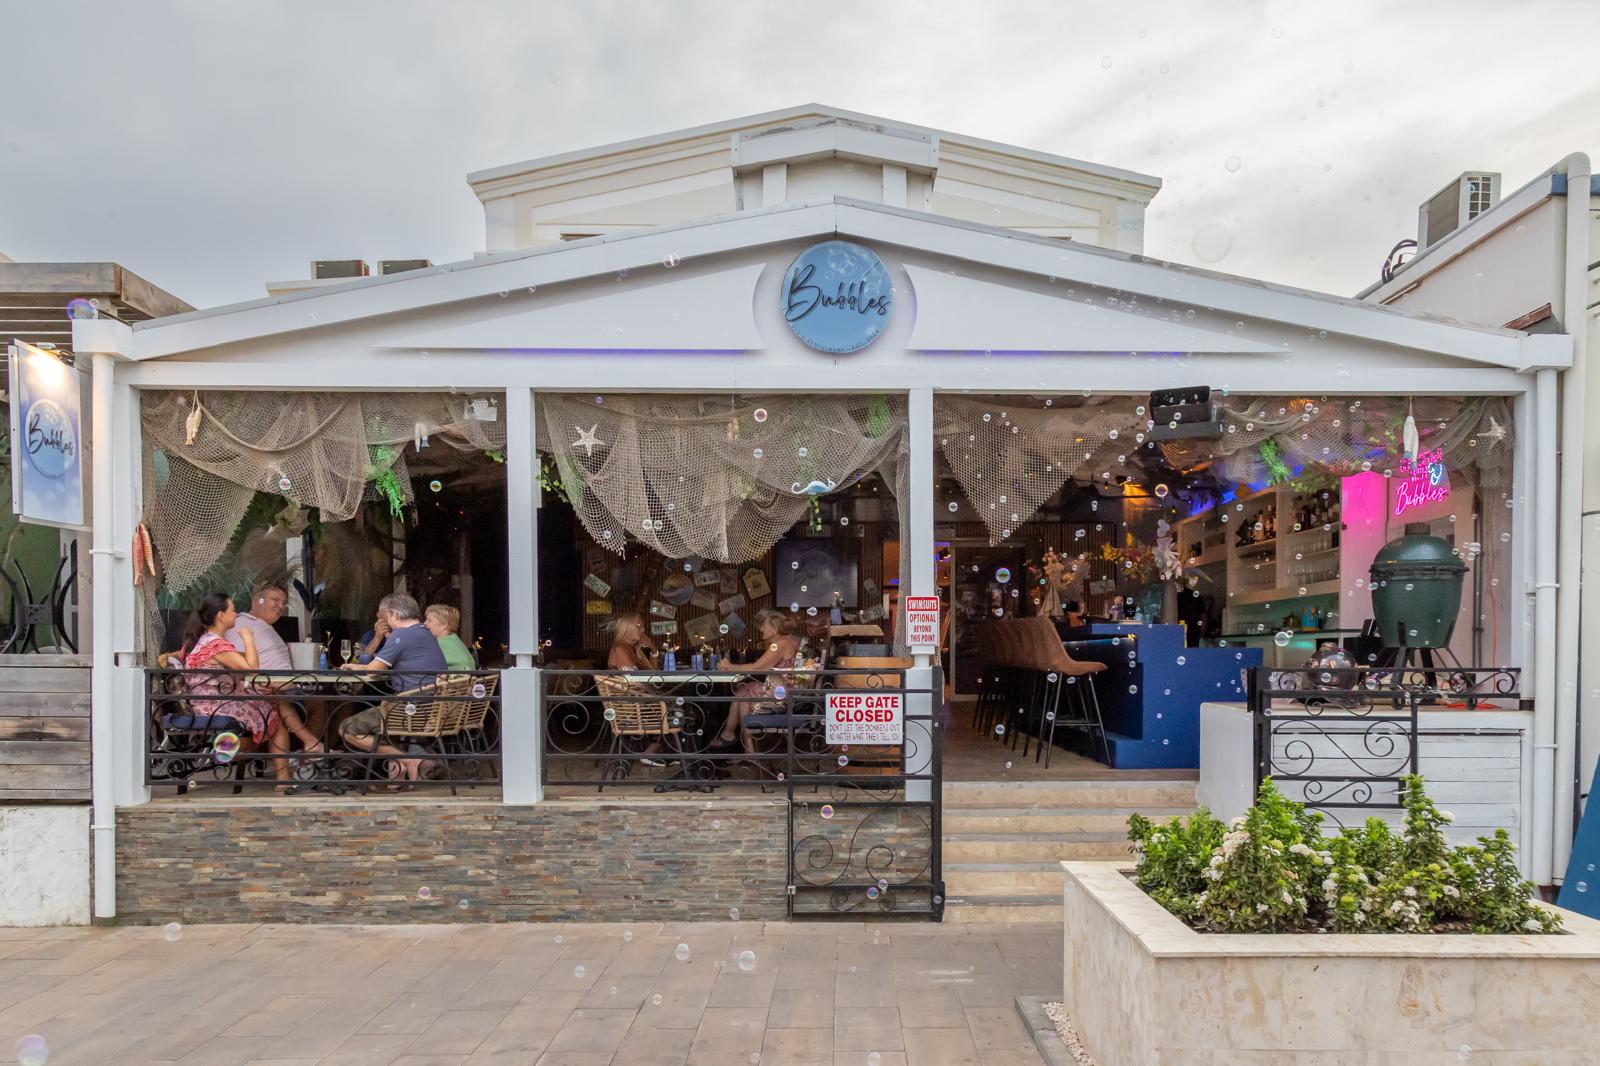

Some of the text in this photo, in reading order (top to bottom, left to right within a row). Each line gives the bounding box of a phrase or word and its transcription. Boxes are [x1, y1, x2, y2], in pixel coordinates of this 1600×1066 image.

[785, 261, 890, 321] Bubbles
[28, 413, 74, 456] Bubbles
[1396, 481, 1448, 515] Bubbles
[908, 600, 937, 610] SWIMSUITS
[909, 613, 936, 622] OPTIONAL
[910, 634, 935, 642] THIS POINT
[829, 696, 899, 709] KEEP GATE
[835, 709, 894, 722] CLOSED
